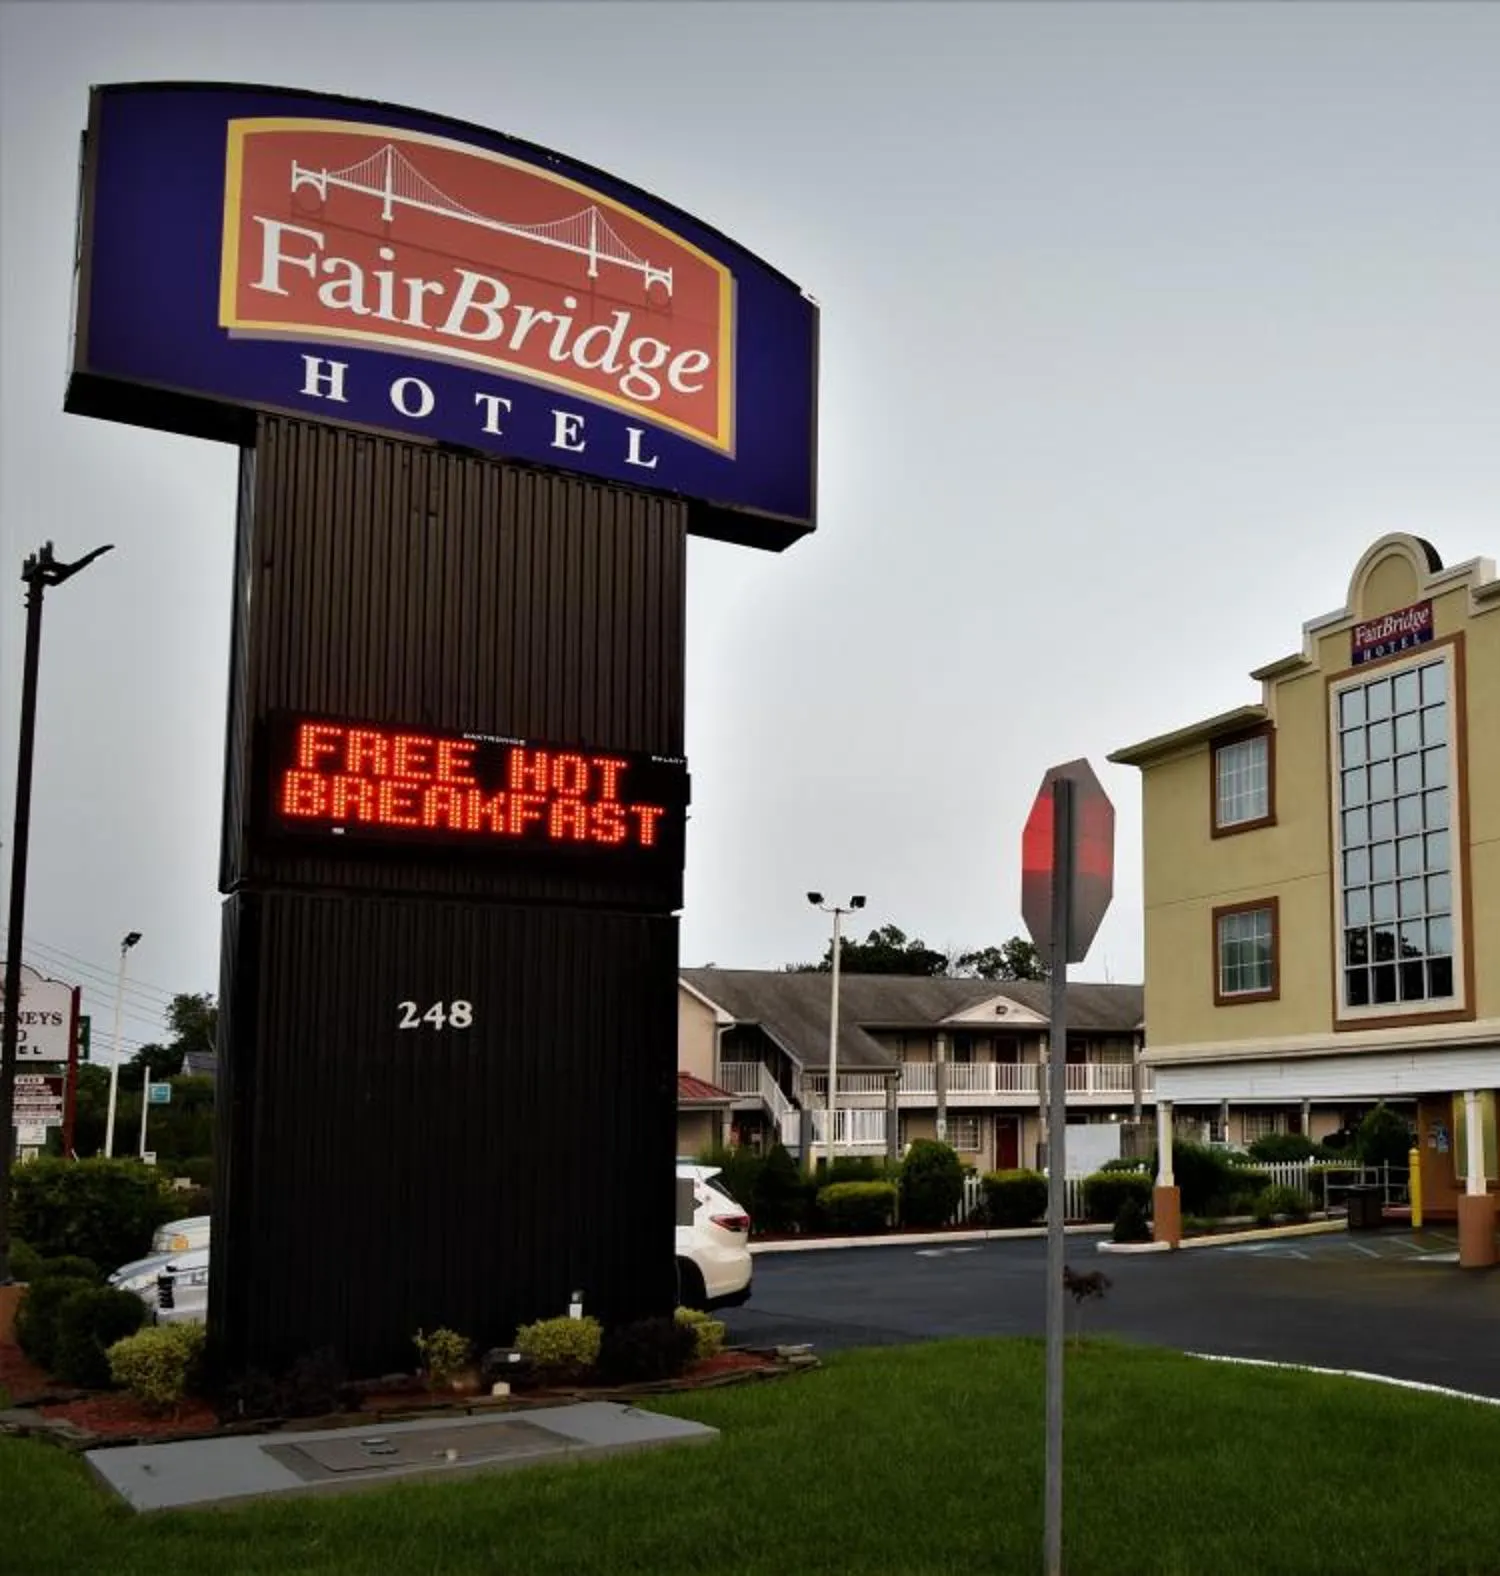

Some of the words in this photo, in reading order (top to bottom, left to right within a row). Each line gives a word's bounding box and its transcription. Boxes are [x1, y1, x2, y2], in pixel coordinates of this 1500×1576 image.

[251, 215, 711, 402] FairBridge
[299, 354, 660, 469] HOTEL
[1355, 607, 1429, 647] FairBridge
[1363, 633, 1421, 661] HOTEL
[300, 723, 477, 785] FREE
[510, 747, 628, 800] HOT
[282, 769, 665, 846] BREAKFAST
[398, 1001, 473, 1030] 248
